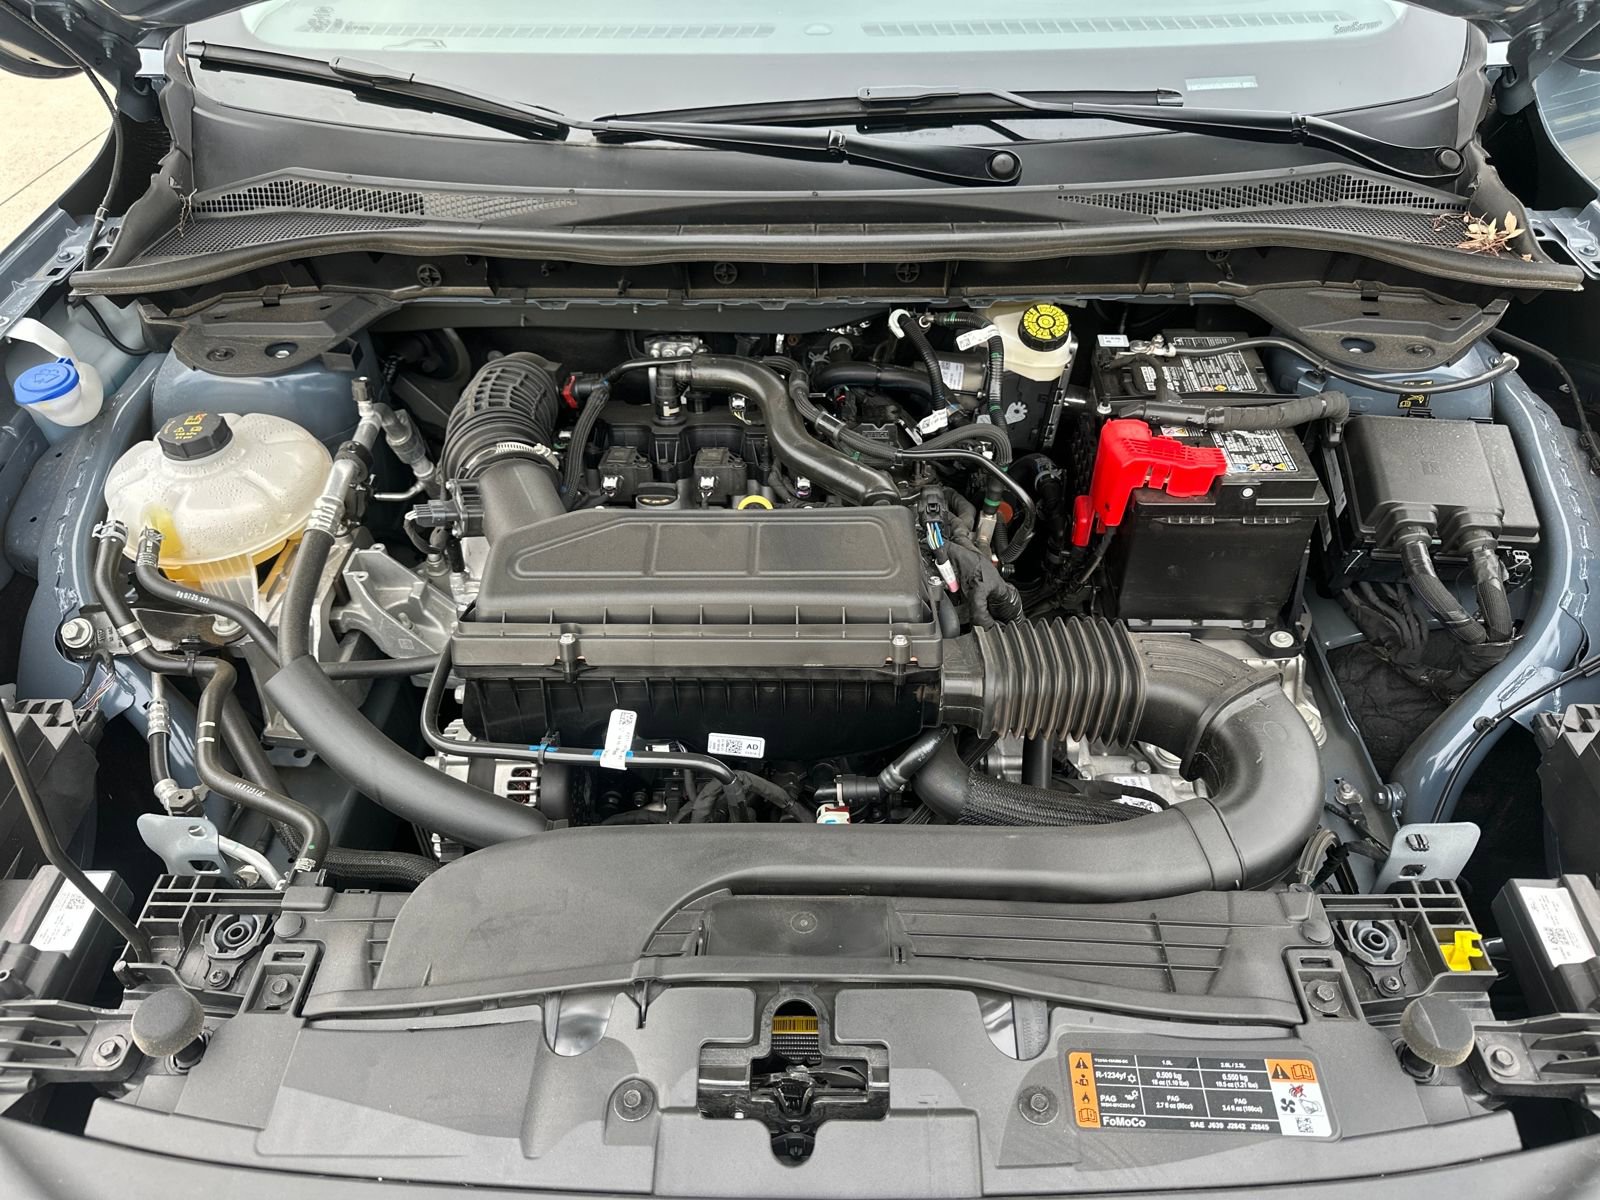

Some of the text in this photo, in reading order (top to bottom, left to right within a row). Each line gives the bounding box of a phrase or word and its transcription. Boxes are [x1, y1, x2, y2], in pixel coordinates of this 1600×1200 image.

[746, 743, 759, 751] AD
[1095, 1070, 1127, 1081] R-1234yf
[1173, 1072, 1182, 1081] kg
[1239, 1074, 1249, 1082] kg
[1100, 1094, 1117, 1103] PAG
[1102, 1116, 1147, 1128] FoMoCo
[1189, 1121, 1205, 1129] SAE
